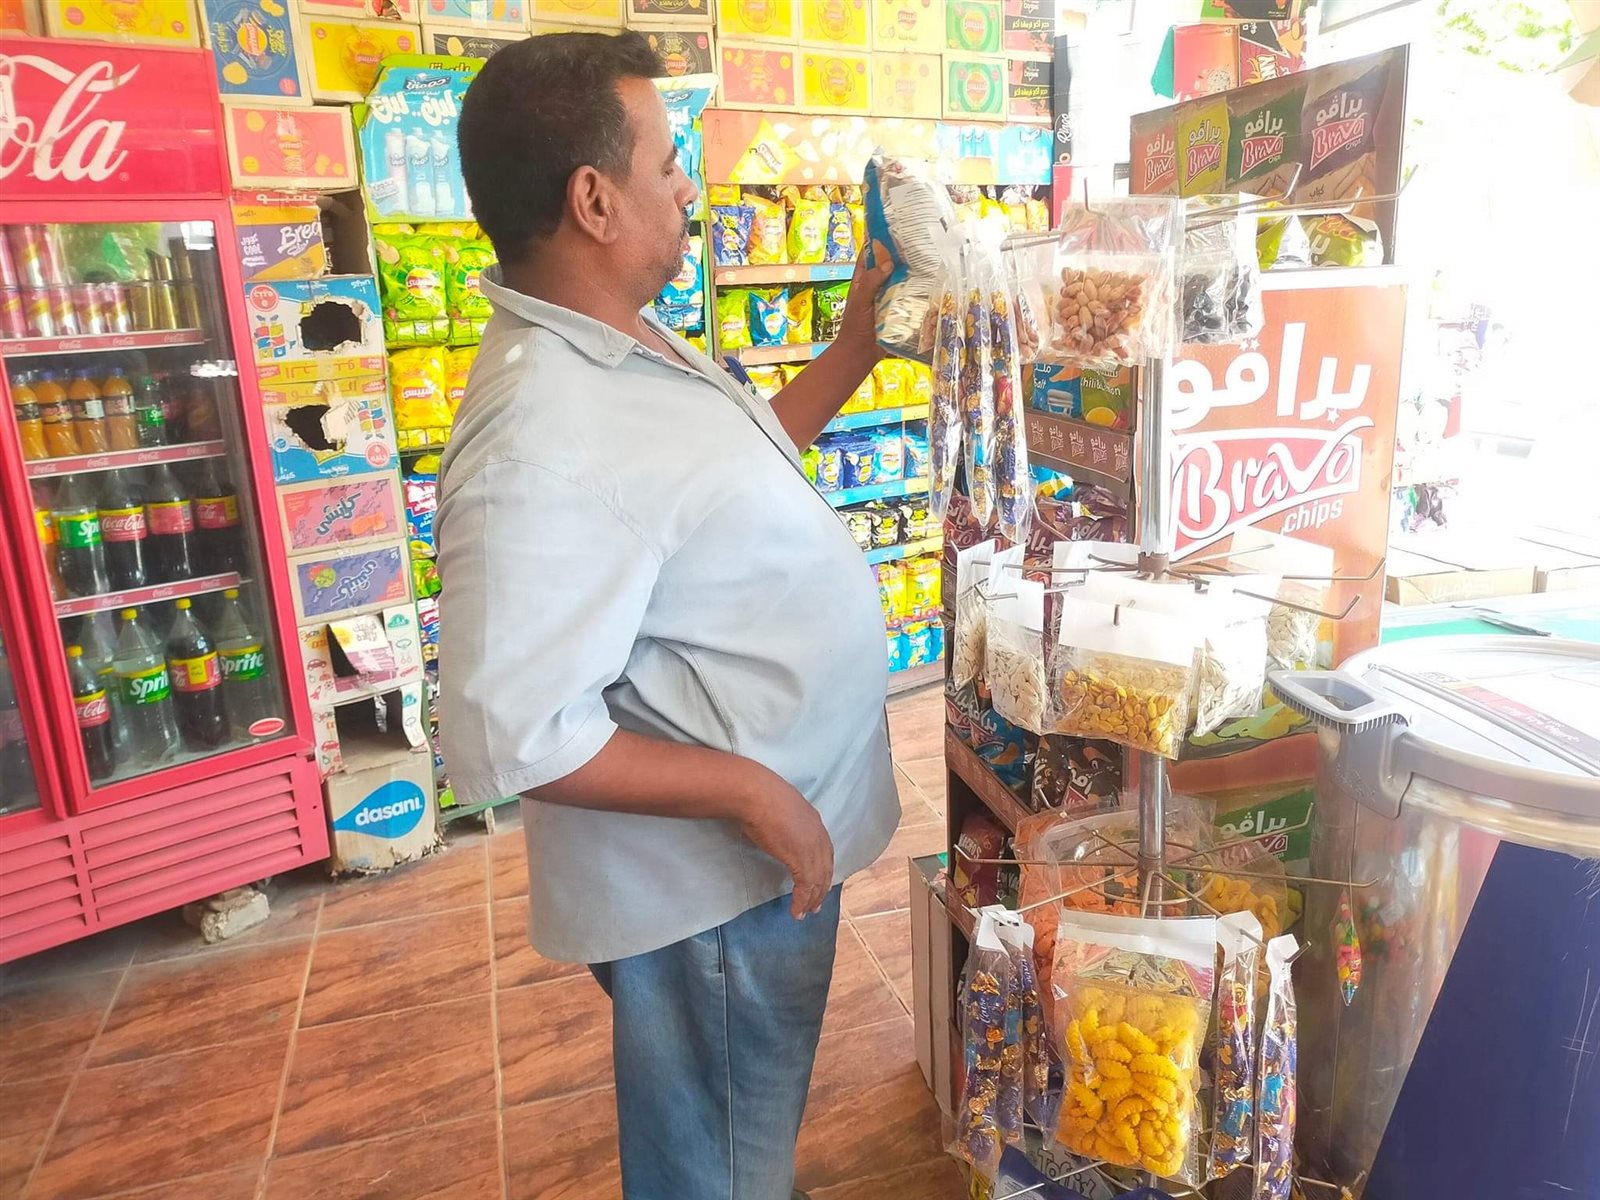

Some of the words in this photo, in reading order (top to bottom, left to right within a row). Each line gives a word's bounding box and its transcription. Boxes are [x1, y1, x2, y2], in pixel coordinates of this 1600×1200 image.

[0, 53, 140, 182] ola
[1173, 416, 1375, 540] Bravo
[102, 514, 145, 532] Coca-Cola
[1282, 499, 1344, 536] chips
[220, 652, 264, 674] Sprite
[130, 671, 169, 698] Sprit
[355, 797, 424, 826] dasani
